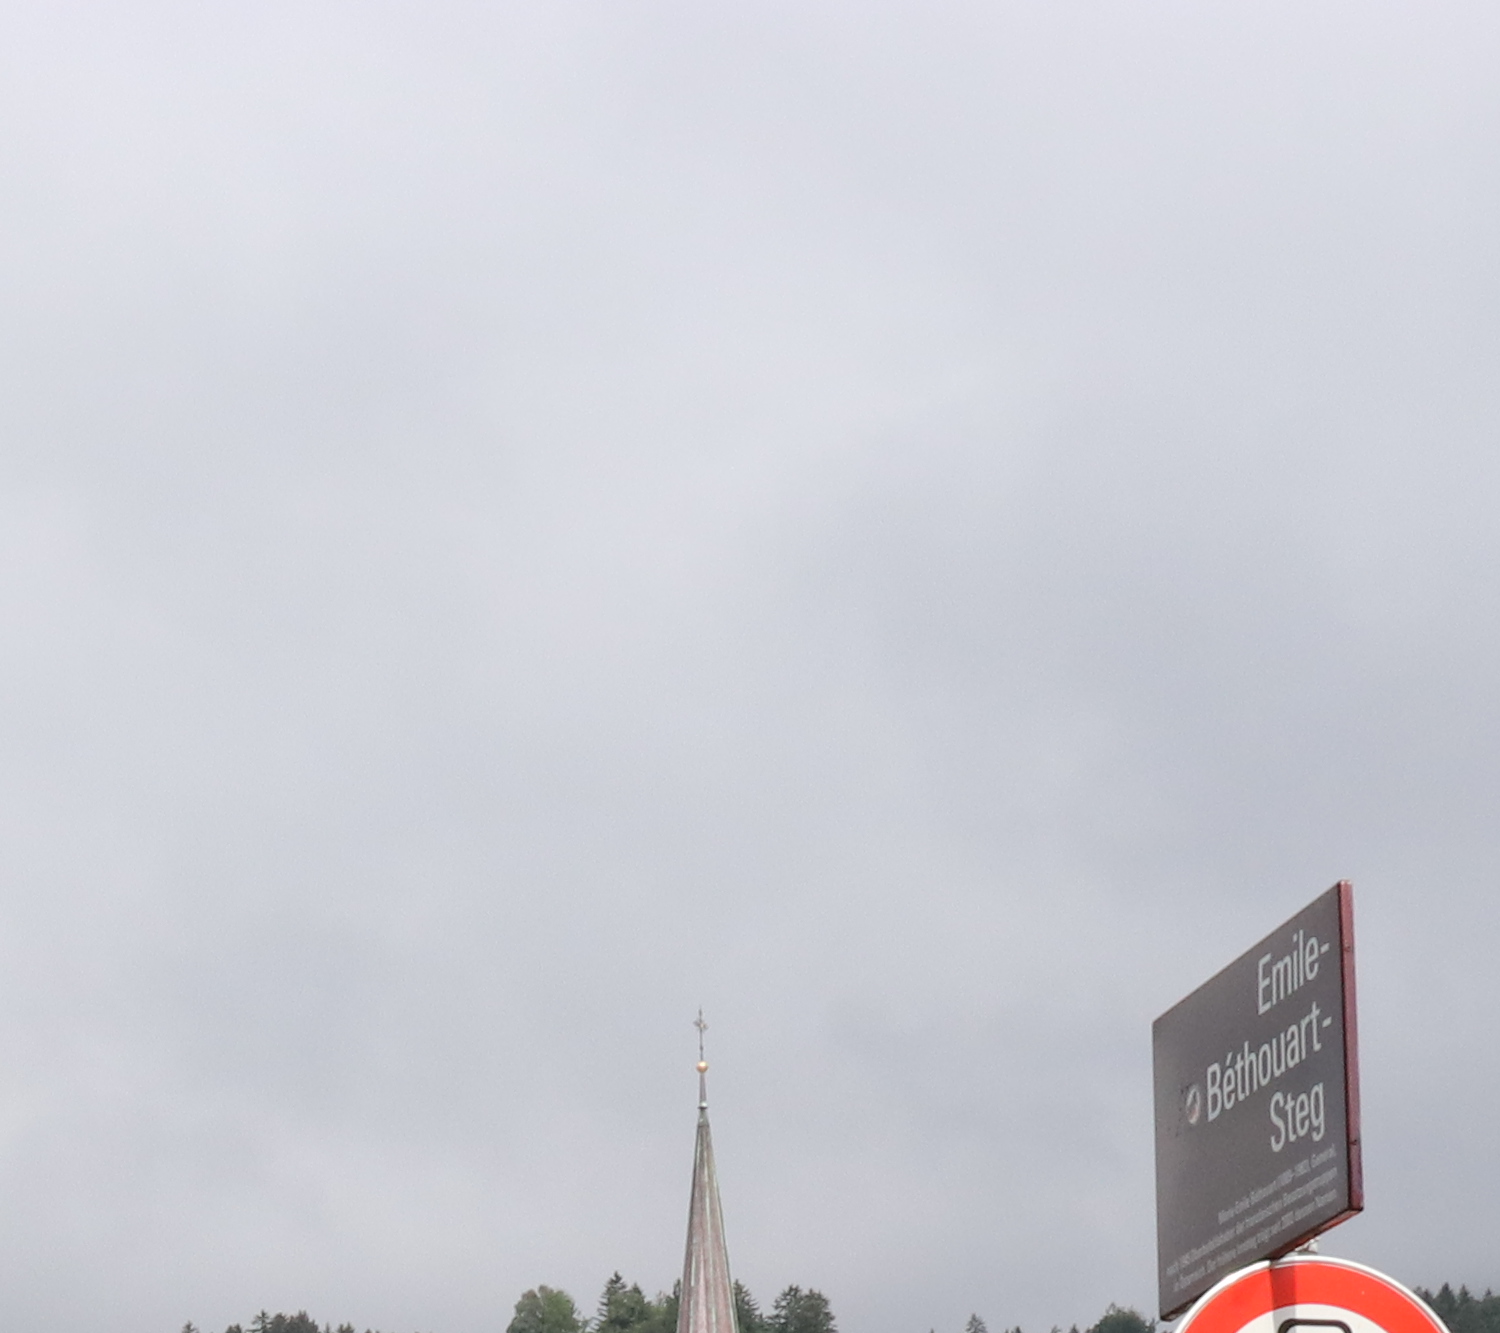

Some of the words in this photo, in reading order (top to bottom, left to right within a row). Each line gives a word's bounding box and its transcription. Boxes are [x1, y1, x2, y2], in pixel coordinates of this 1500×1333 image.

[1257, 929, 1330, 1016] Emile-
[1206, 1000, 1332, 1123] Béthouart-
[1269, 1081, 1325, 1153] Steg
